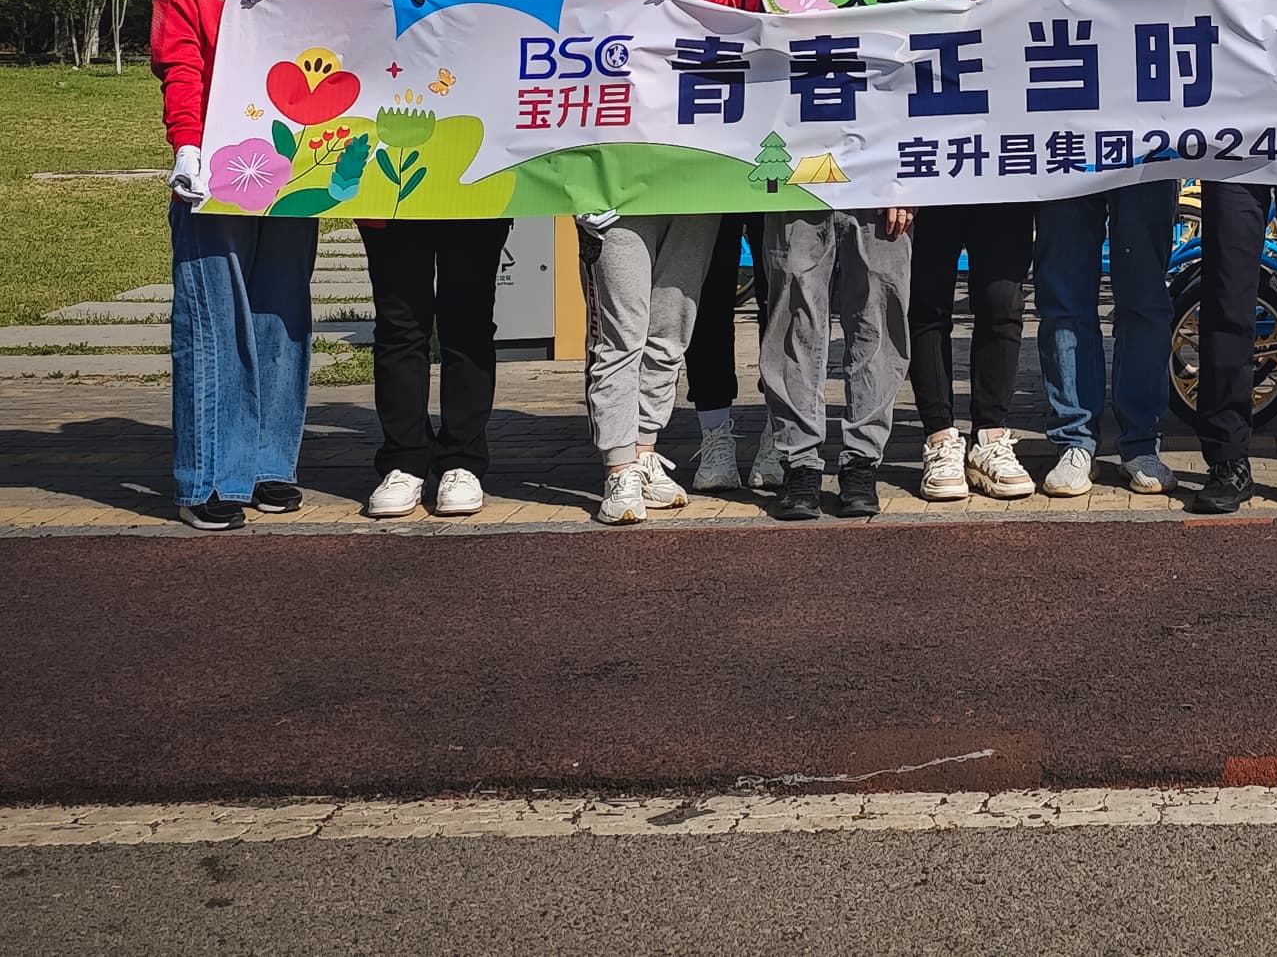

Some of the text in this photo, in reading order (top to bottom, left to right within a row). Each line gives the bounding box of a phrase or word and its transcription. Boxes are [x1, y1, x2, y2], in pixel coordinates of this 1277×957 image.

[519, 35, 635, 80] BSC
[515, 83, 632, 130] 宝升昌
